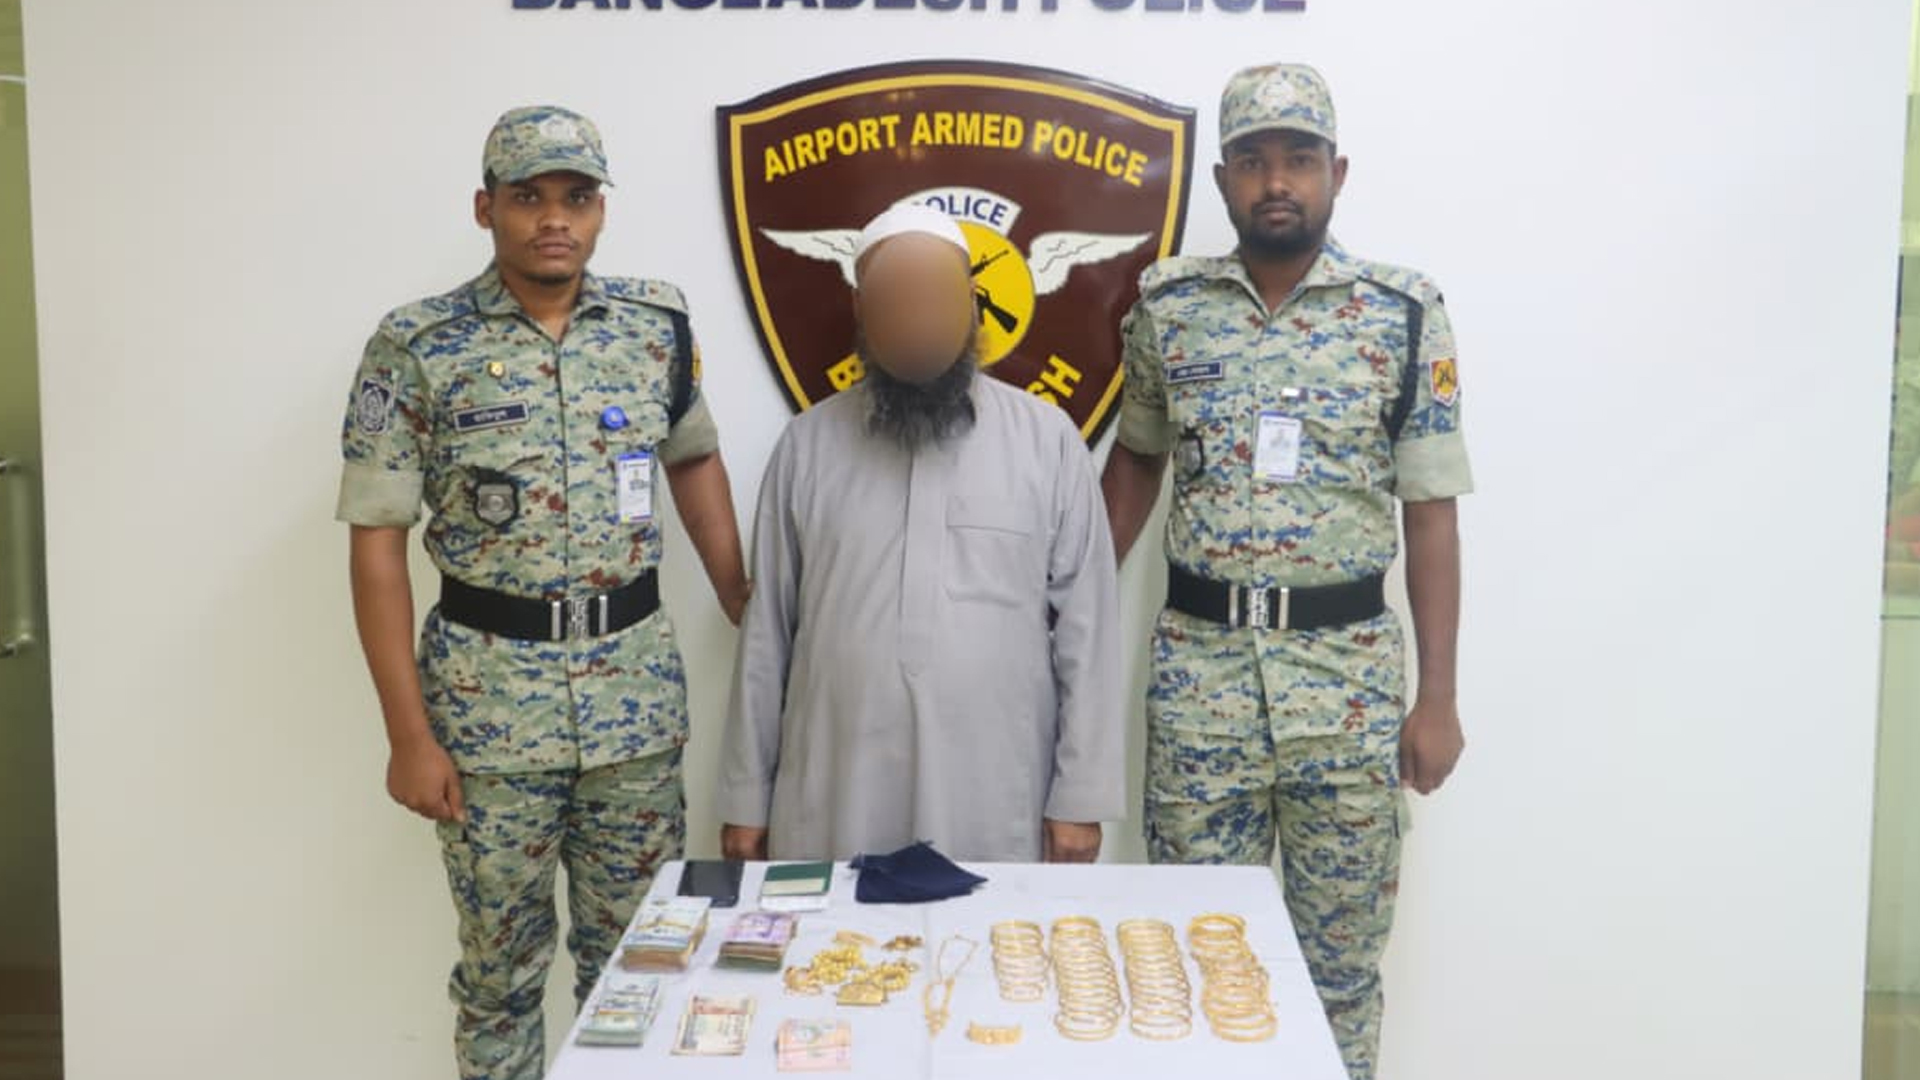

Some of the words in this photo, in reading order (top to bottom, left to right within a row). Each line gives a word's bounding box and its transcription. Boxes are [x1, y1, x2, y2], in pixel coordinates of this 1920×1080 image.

[764, 114, 902, 183] AIRPORT
[910, 111, 1025, 151] ARMED
[1032, 122, 1148, 187] POLICE
[912, 194, 1009, 227] OLICE
